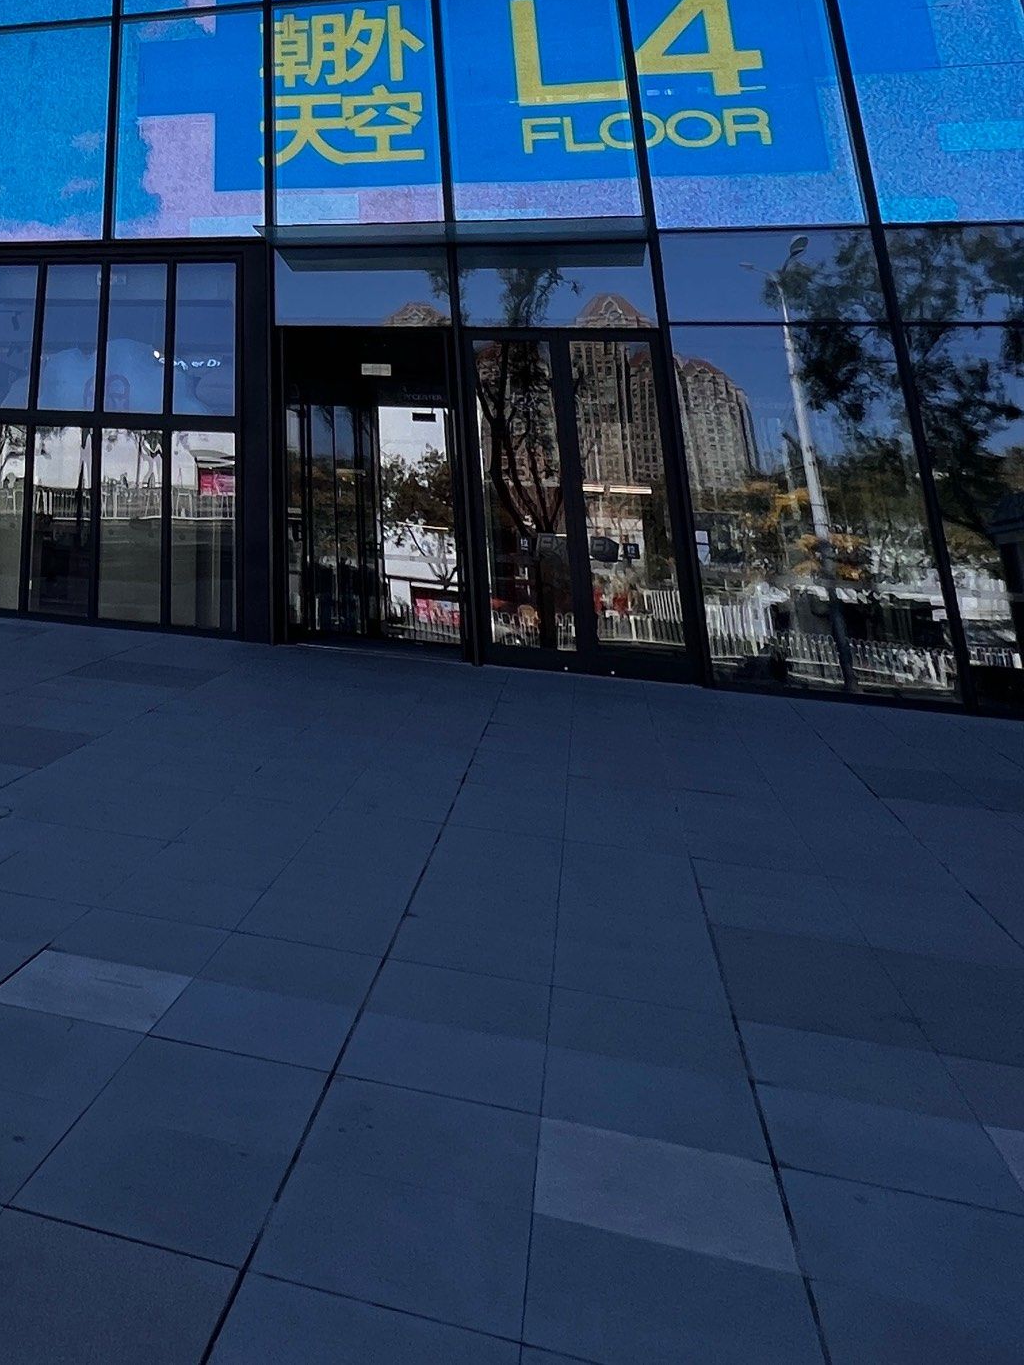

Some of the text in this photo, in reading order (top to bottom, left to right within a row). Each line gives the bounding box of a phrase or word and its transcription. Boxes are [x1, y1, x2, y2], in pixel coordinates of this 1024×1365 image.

[260, 4, 425, 88] 朝外
[259, 84, 425, 166] 天空
[522, 107, 772, 154] FLOOR
